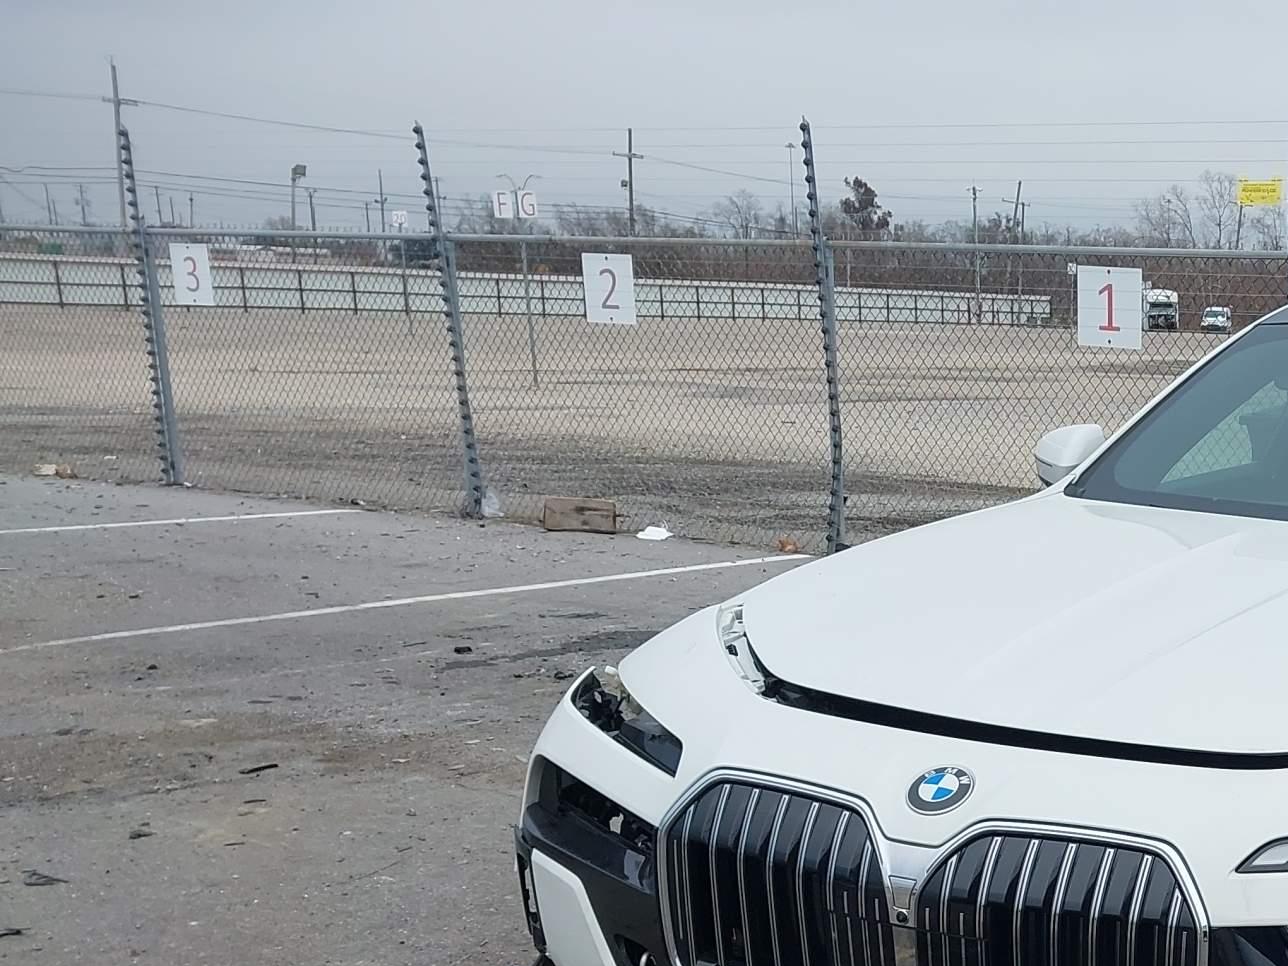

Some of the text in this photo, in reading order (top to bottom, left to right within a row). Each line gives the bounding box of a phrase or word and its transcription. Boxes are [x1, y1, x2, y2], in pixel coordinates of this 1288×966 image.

[496, 192, 507, 217] F
[520, 192, 535, 217] G
[183, 256, 200, 292] 3
[599, 268, 620, 310] 2
[1098, 283, 1121, 332] 1
